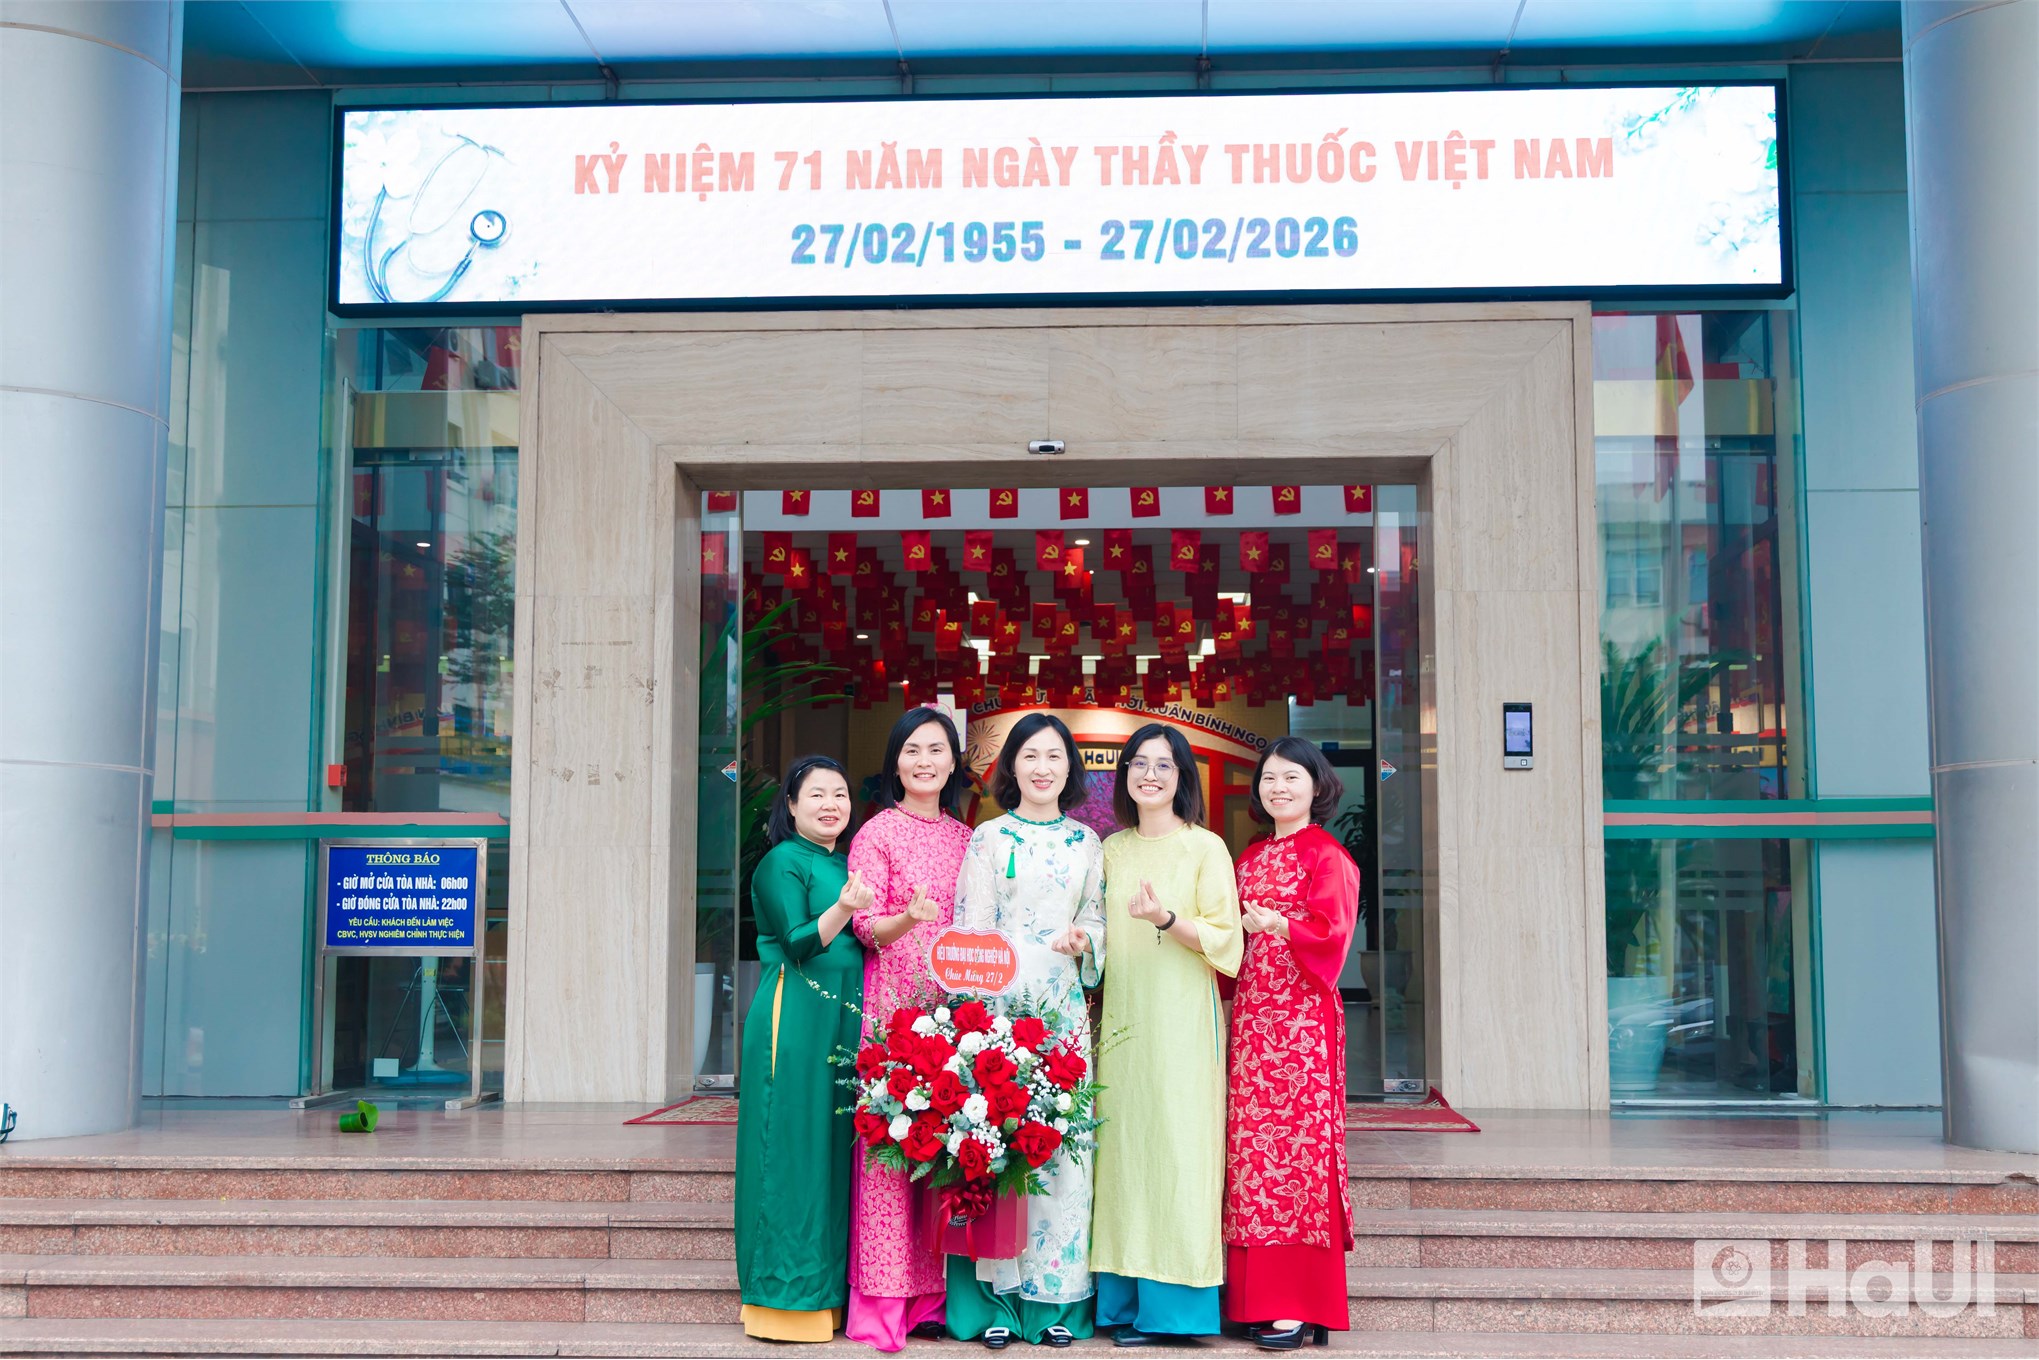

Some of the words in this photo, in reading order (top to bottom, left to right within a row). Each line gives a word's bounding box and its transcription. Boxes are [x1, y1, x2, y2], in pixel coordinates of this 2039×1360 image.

[574, 141, 628, 195] KỶ
[644, 143, 755, 202] NIỆM
[774, 150, 822, 191] 71
[845, 141, 943, 190] NĂM
[962, 137, 1078, 188] NGÀY
[1094, 130, 1209, 186] THẦY
[1223, 127, 1377, 184] THUỐC
[1395, 129, 1496, 190] VIỆT
[1513, 138, 1614, 180] NAM
[790, 221, 1046, 269] 27/02/1955
[1099, 215, 1359, 264] 27/02/2026
[1195, 713, 1232, 734] BÍNH
[1234, 727, 1267, 750] NGỌ
[1084, 750, 1119, 765] HaUI
[366, 852, 411, 864] THÔNG
[413, 852, 441, 864] BÁO
[343, 873, 359, 890] GIỜ
[360, 871, 375, 890] MỞ
[376, 871, 394, 890] CỬA
[396, 873, 413, 890] TÒA
[415, 874, 437, 890] NHÀ:
[441, 877, 468, 890] 06h00
[342, 894, 357, 911] GIỜ
[357, 894, 381, 911] ĐÓNG
[383, 892, 400, 911] CỬA
[401, 894, 418, 911] TÒA
[419, 894, 440, 911] NHÀ:
[441, 897, 468, 911] 22h00
[348, 916, 363, 927] YÊU
[381, 916, 406, 927] KHÁCH
[438, 917, 454, 928] VIỆC
[359, 930, 377, 938] HVSV
[378, 929, 405, 938] NGHIÊM
[448, 929, 465, 940] HIỆN
[985, 971, 1003, 986] 27/2
